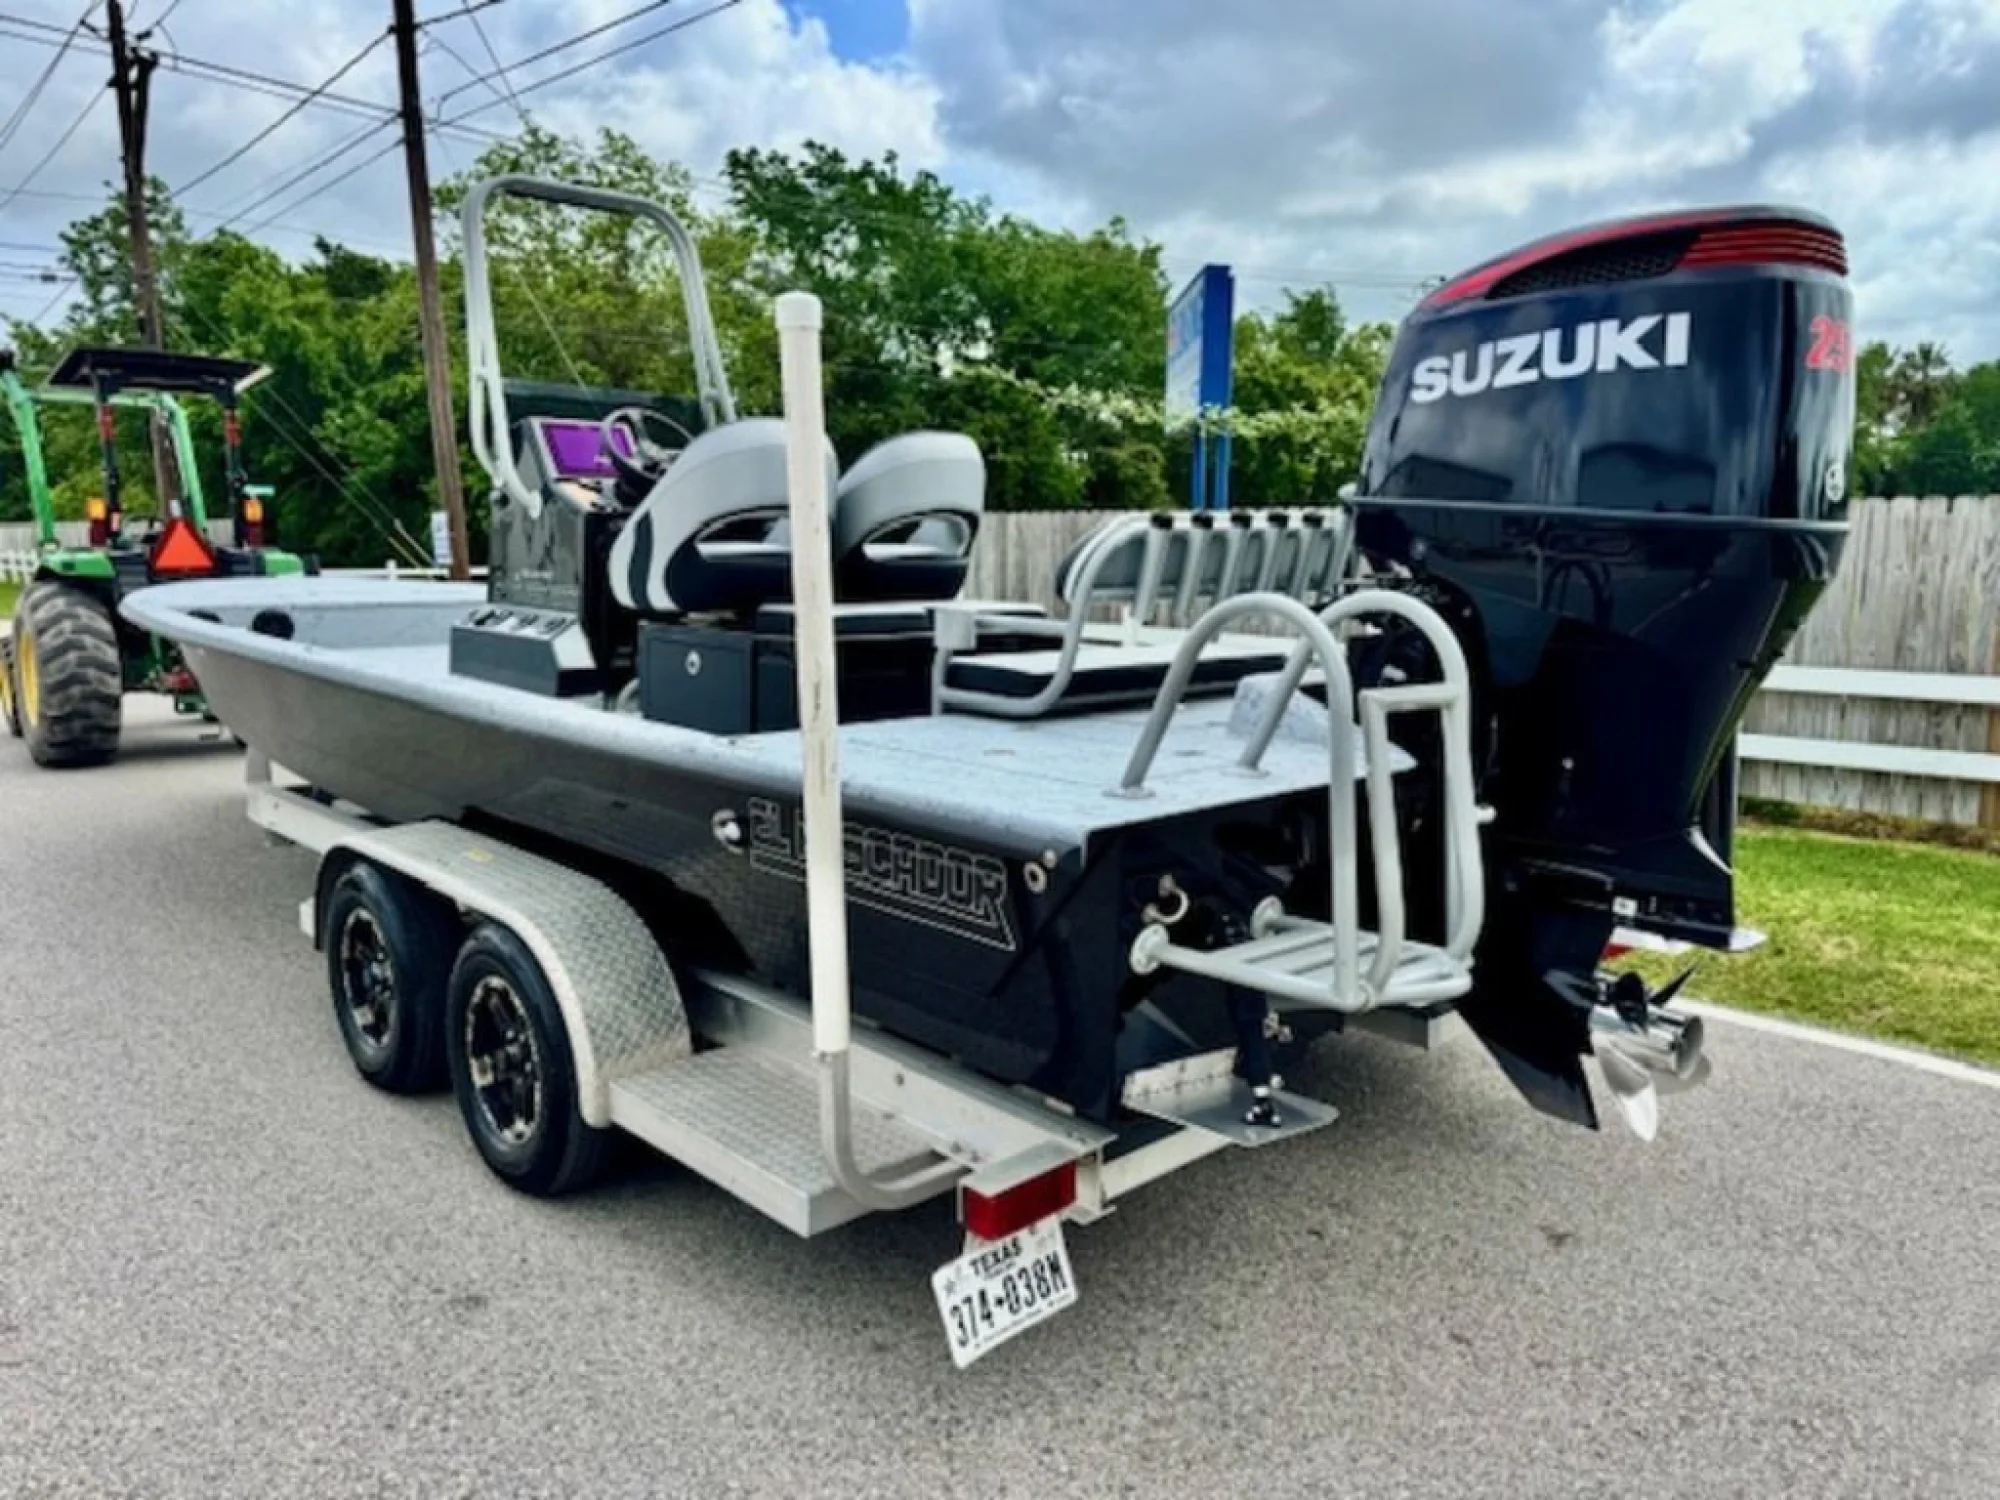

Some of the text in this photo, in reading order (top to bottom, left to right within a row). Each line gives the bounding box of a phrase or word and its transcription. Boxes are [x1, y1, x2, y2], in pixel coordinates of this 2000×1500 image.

[1411, 312, 1691, 403] SUZUKI
[793, 808, 1007, 920] SCADOR
[968, 1236, 1022, 1276] TEXAS
